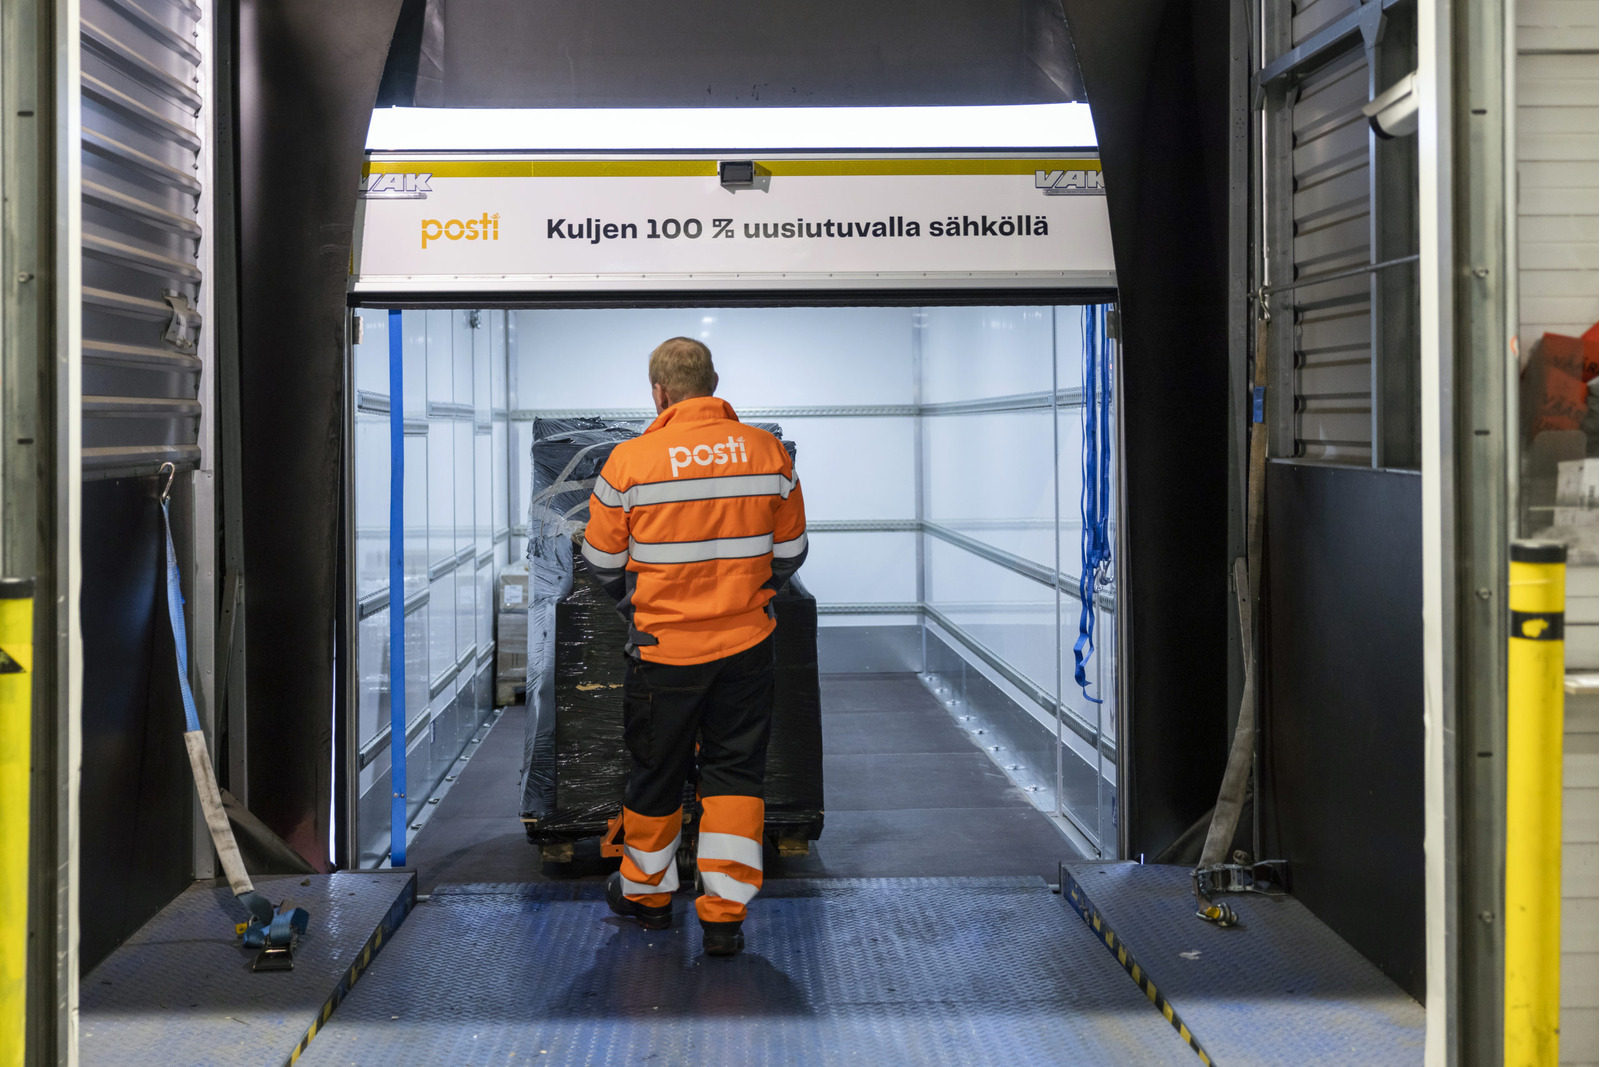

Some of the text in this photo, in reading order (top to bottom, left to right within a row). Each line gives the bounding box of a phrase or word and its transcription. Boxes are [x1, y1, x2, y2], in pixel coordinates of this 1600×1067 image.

[358, 173, 433, 192] VAK
[1035, 170, 1106, 189] VAK
[421, 212, 501, 250] posti
[547, 214, 1049, 245] Kuljen 100 % uusiutuvalla sähköllä
[668, 436, 748, 478] posti
